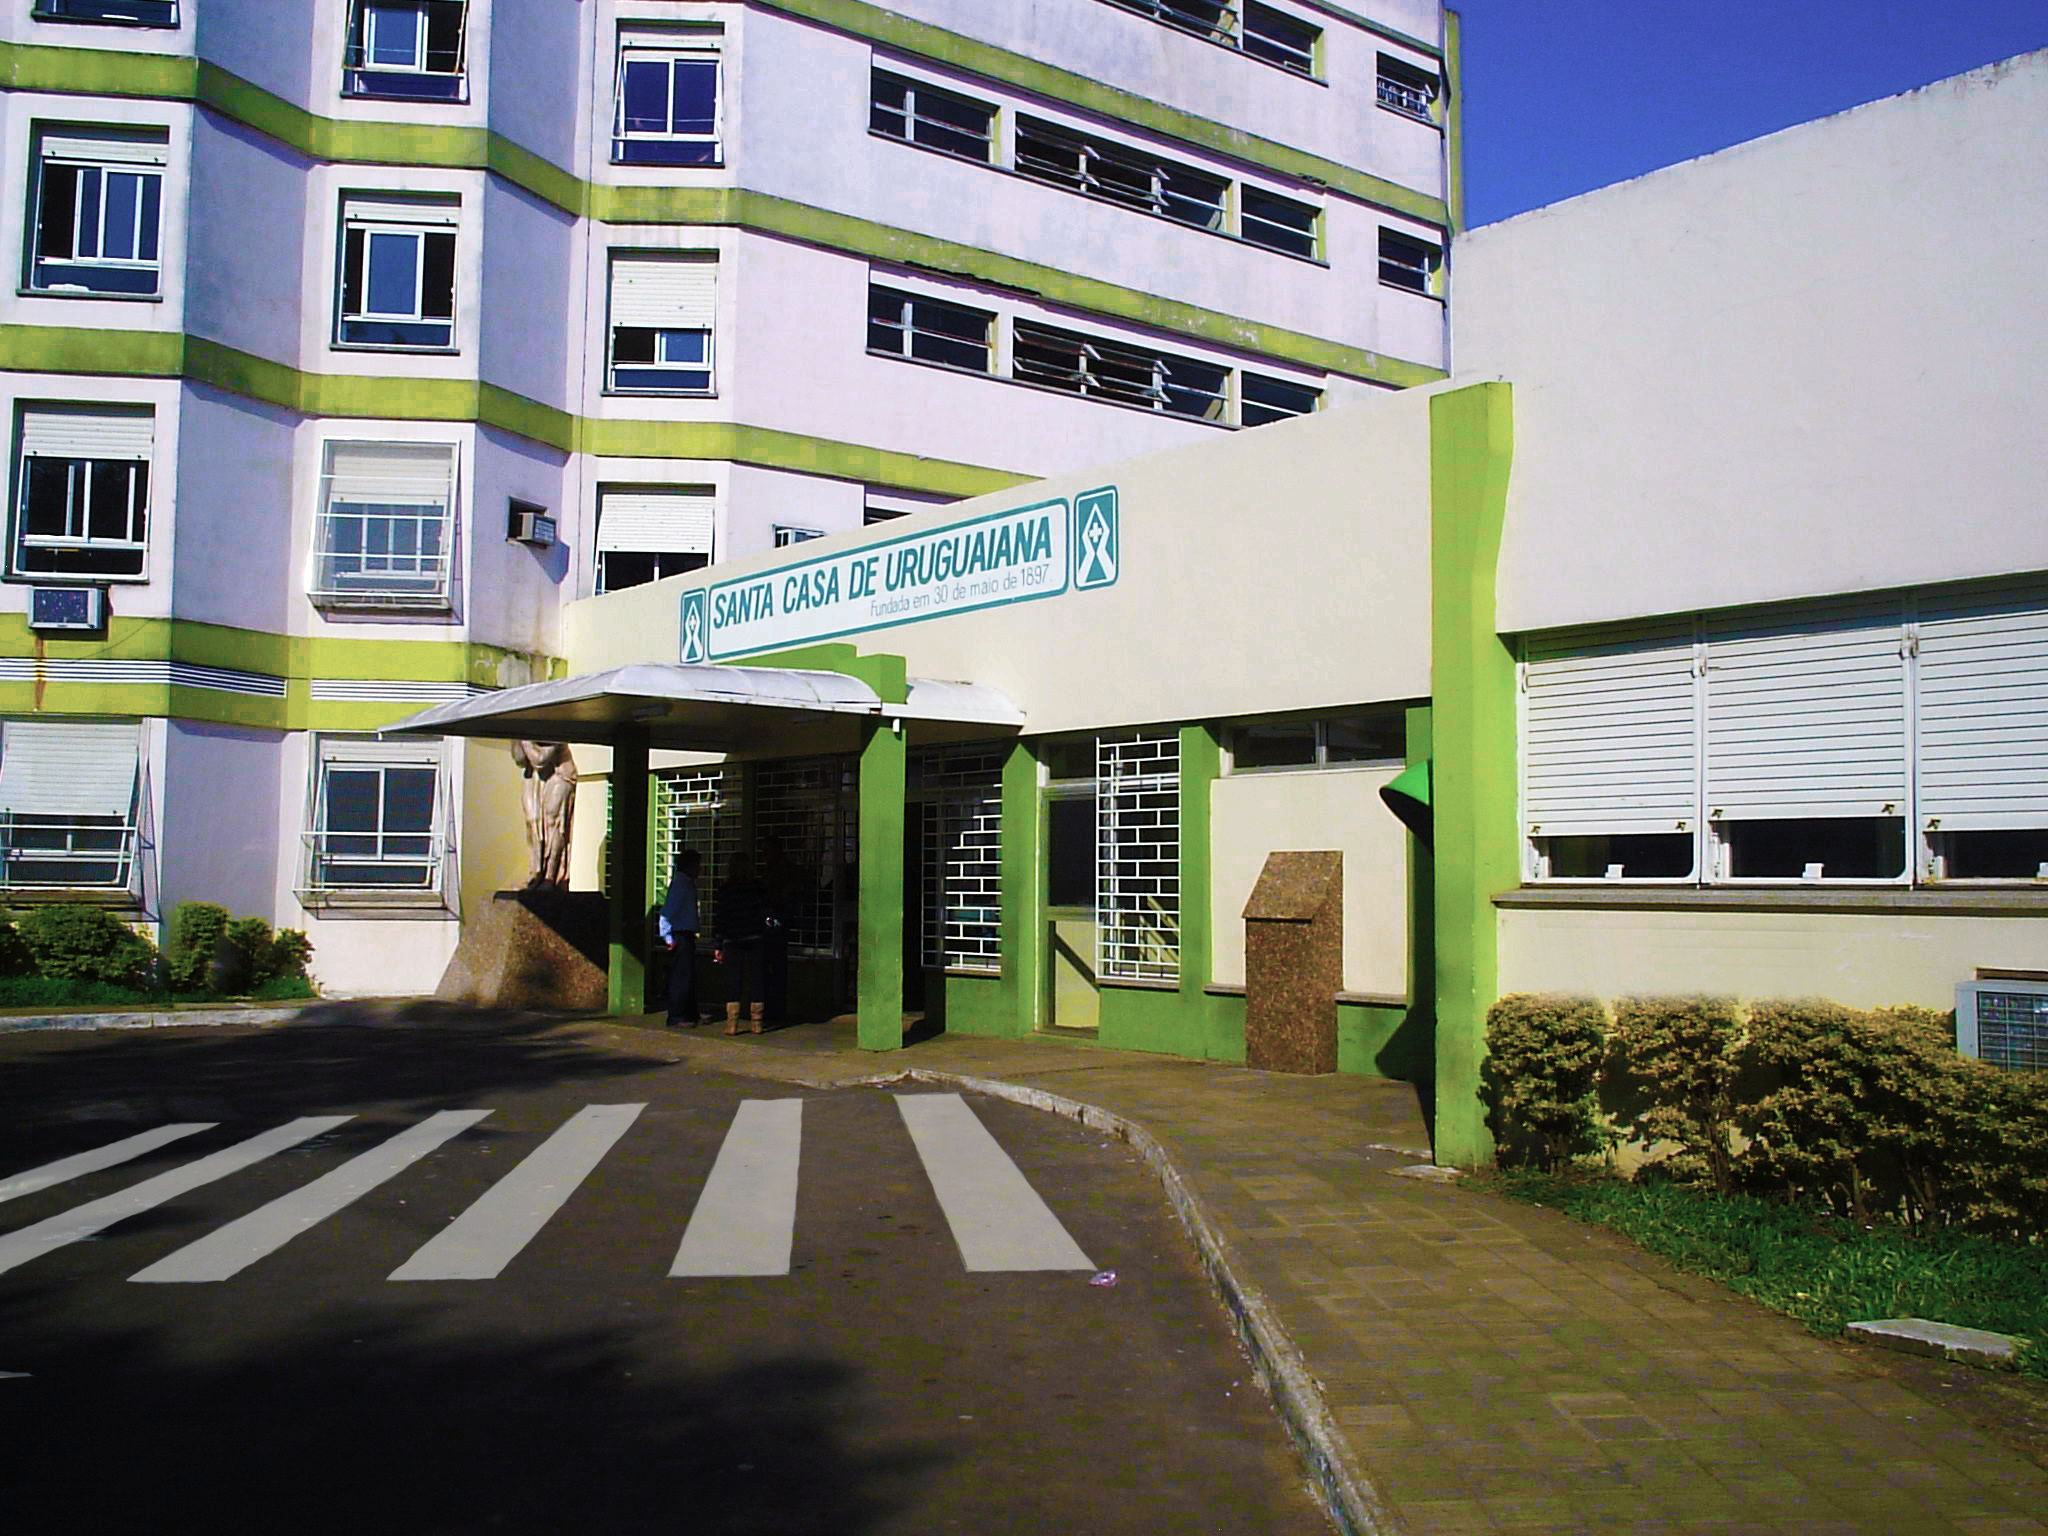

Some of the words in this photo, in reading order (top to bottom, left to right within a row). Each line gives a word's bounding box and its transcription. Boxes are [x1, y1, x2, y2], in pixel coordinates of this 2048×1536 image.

[713, 582, 774, 629] SANTA
[782, 566, 839, 614] CASA
[848, 556, 880, 600] DE
[885, 516, 1052, 591] URUGUAIANA
[870, 594, 910, 617] Fundada
[913, 594, 930, 609] em
[934, 584, 949, 604] 30
[952, 582, 966, 600] de
[970, 579, 999, 597] maio
[1003, 571, 1017, 591] de
